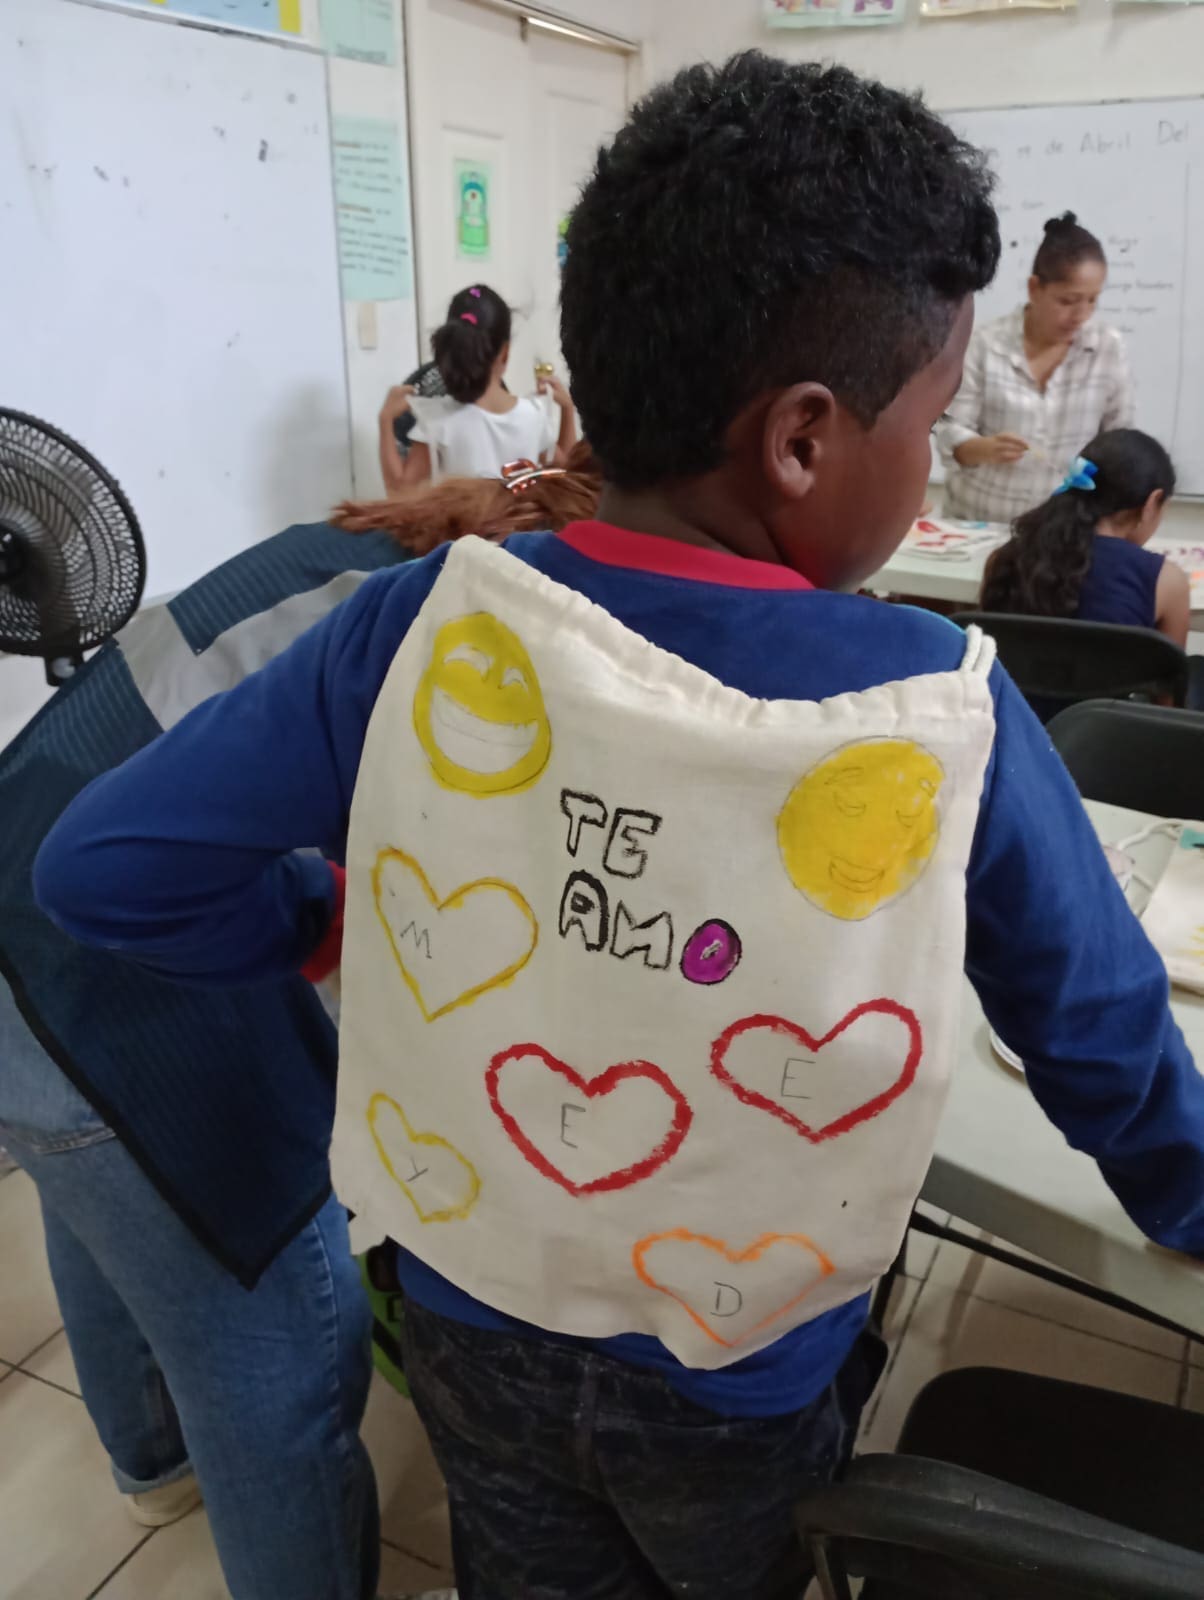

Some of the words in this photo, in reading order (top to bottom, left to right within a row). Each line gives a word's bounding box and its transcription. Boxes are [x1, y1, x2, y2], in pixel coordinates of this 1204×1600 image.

[1079, 131, 1131, 155] Abril
[1156, 119, 1189, 146] Del
[560, 788, 662, 880] TE
[399, 920, 432, 960] M
[558, 869, 743, 986] AMO
[780, 1057, 817, 1100] E
[560, 1102, 587, 1150] E
[710, 1280, 743, 1318] D
